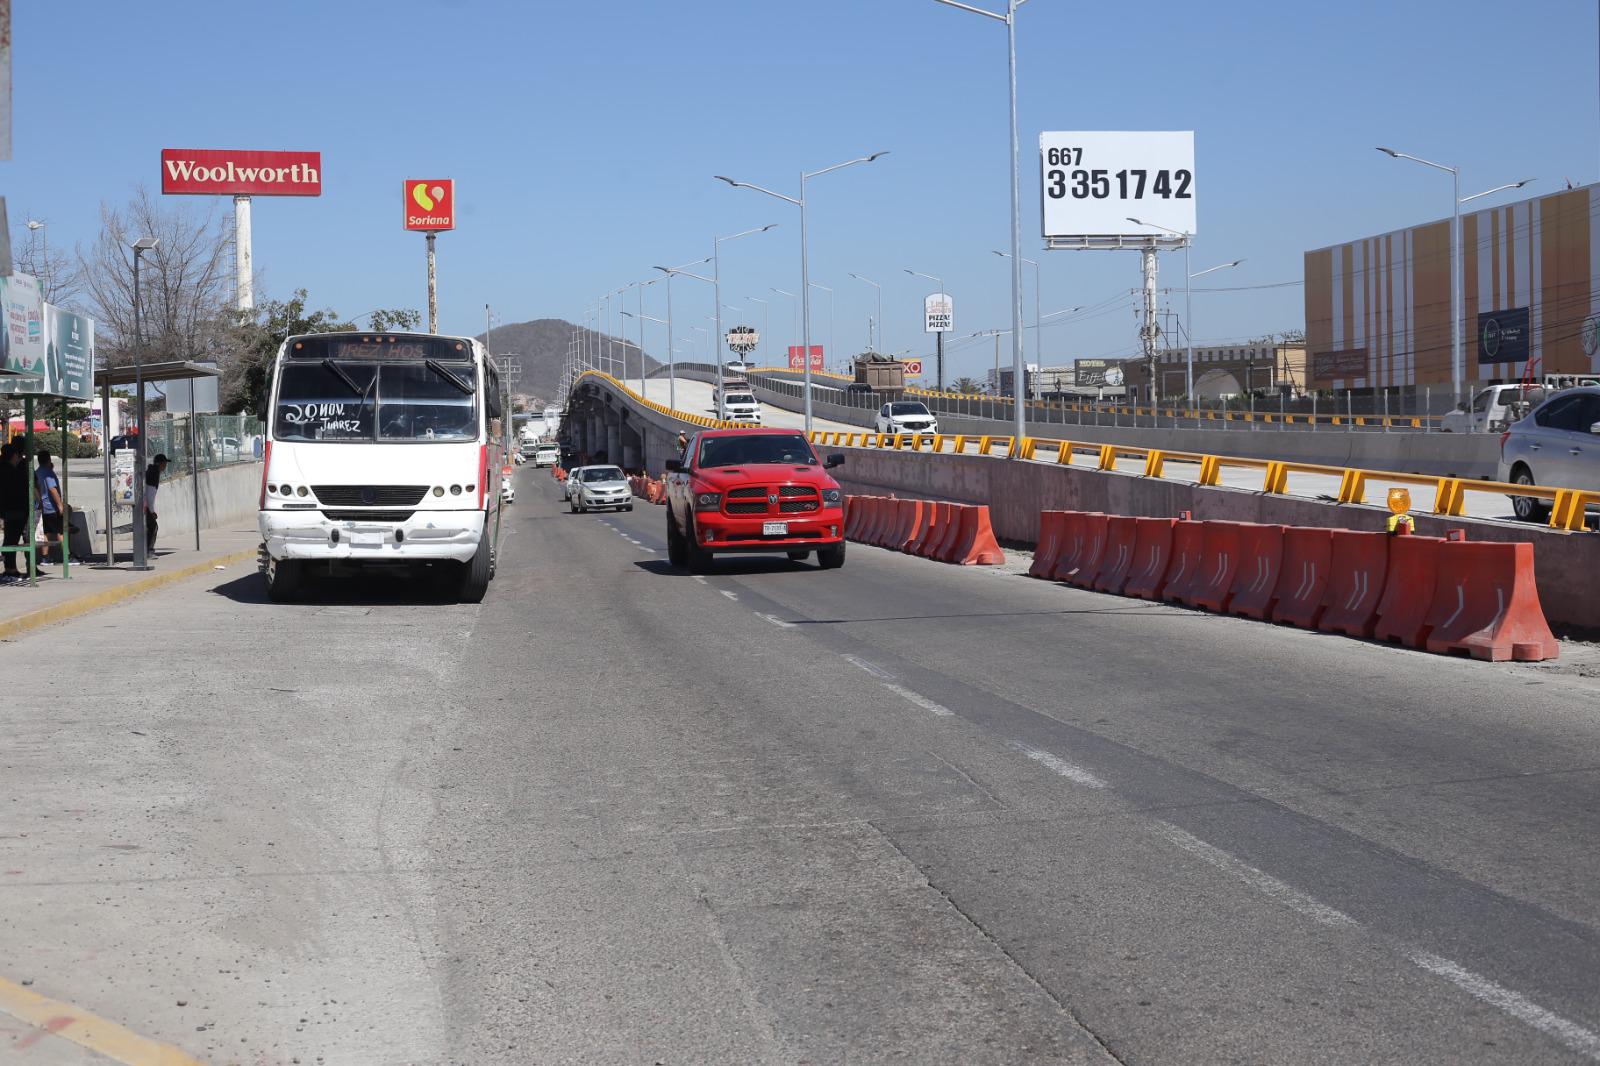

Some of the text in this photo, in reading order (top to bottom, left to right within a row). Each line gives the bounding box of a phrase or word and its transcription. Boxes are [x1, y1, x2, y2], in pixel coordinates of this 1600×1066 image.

[1048, 147, 1083, 166] 667
[165, 160, 319, 183] Woolworth
[409, 215, 449, 225] Soriana
